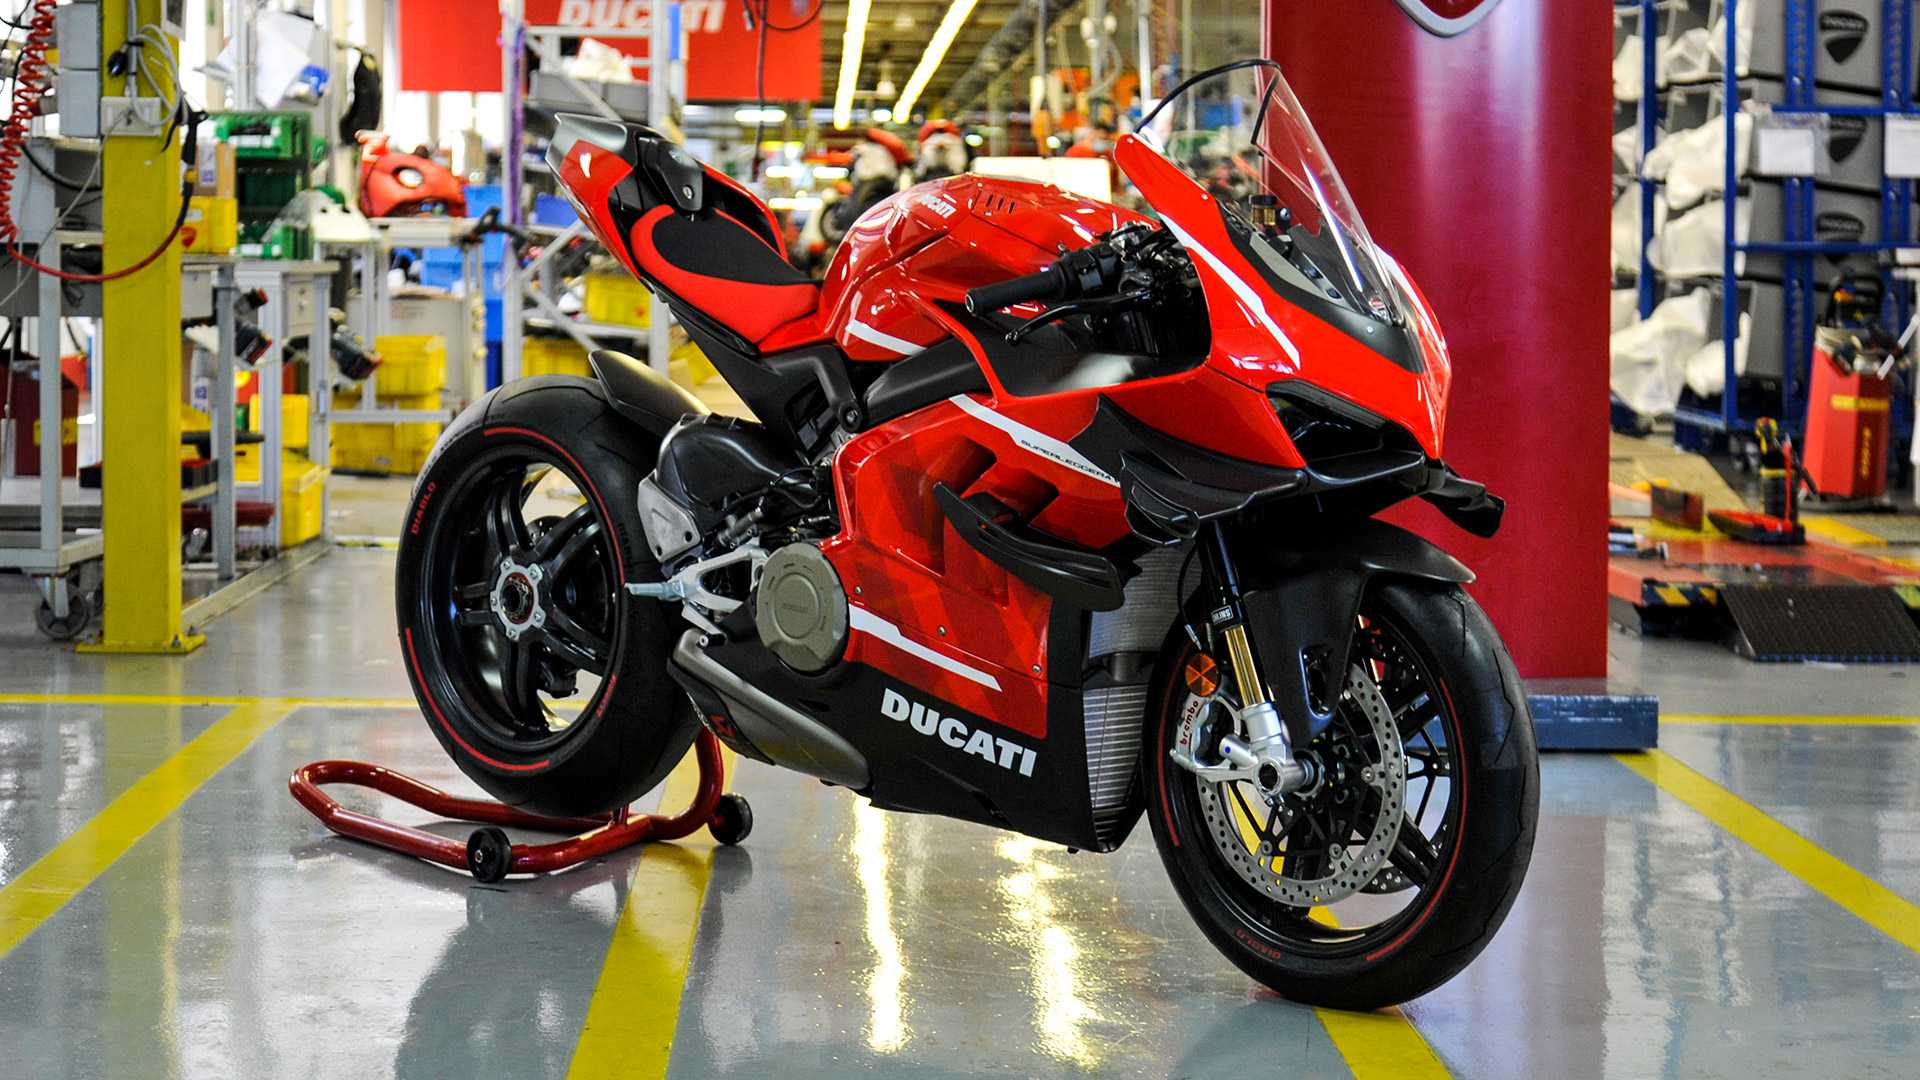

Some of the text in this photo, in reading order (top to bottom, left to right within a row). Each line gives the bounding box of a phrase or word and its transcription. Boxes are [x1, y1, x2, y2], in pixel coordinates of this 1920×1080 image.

[556, 0, 726, 32] DUCTI
[880, 687, 1038, 778] DUCATI
[1179, 700, 1199, 746] brembo
